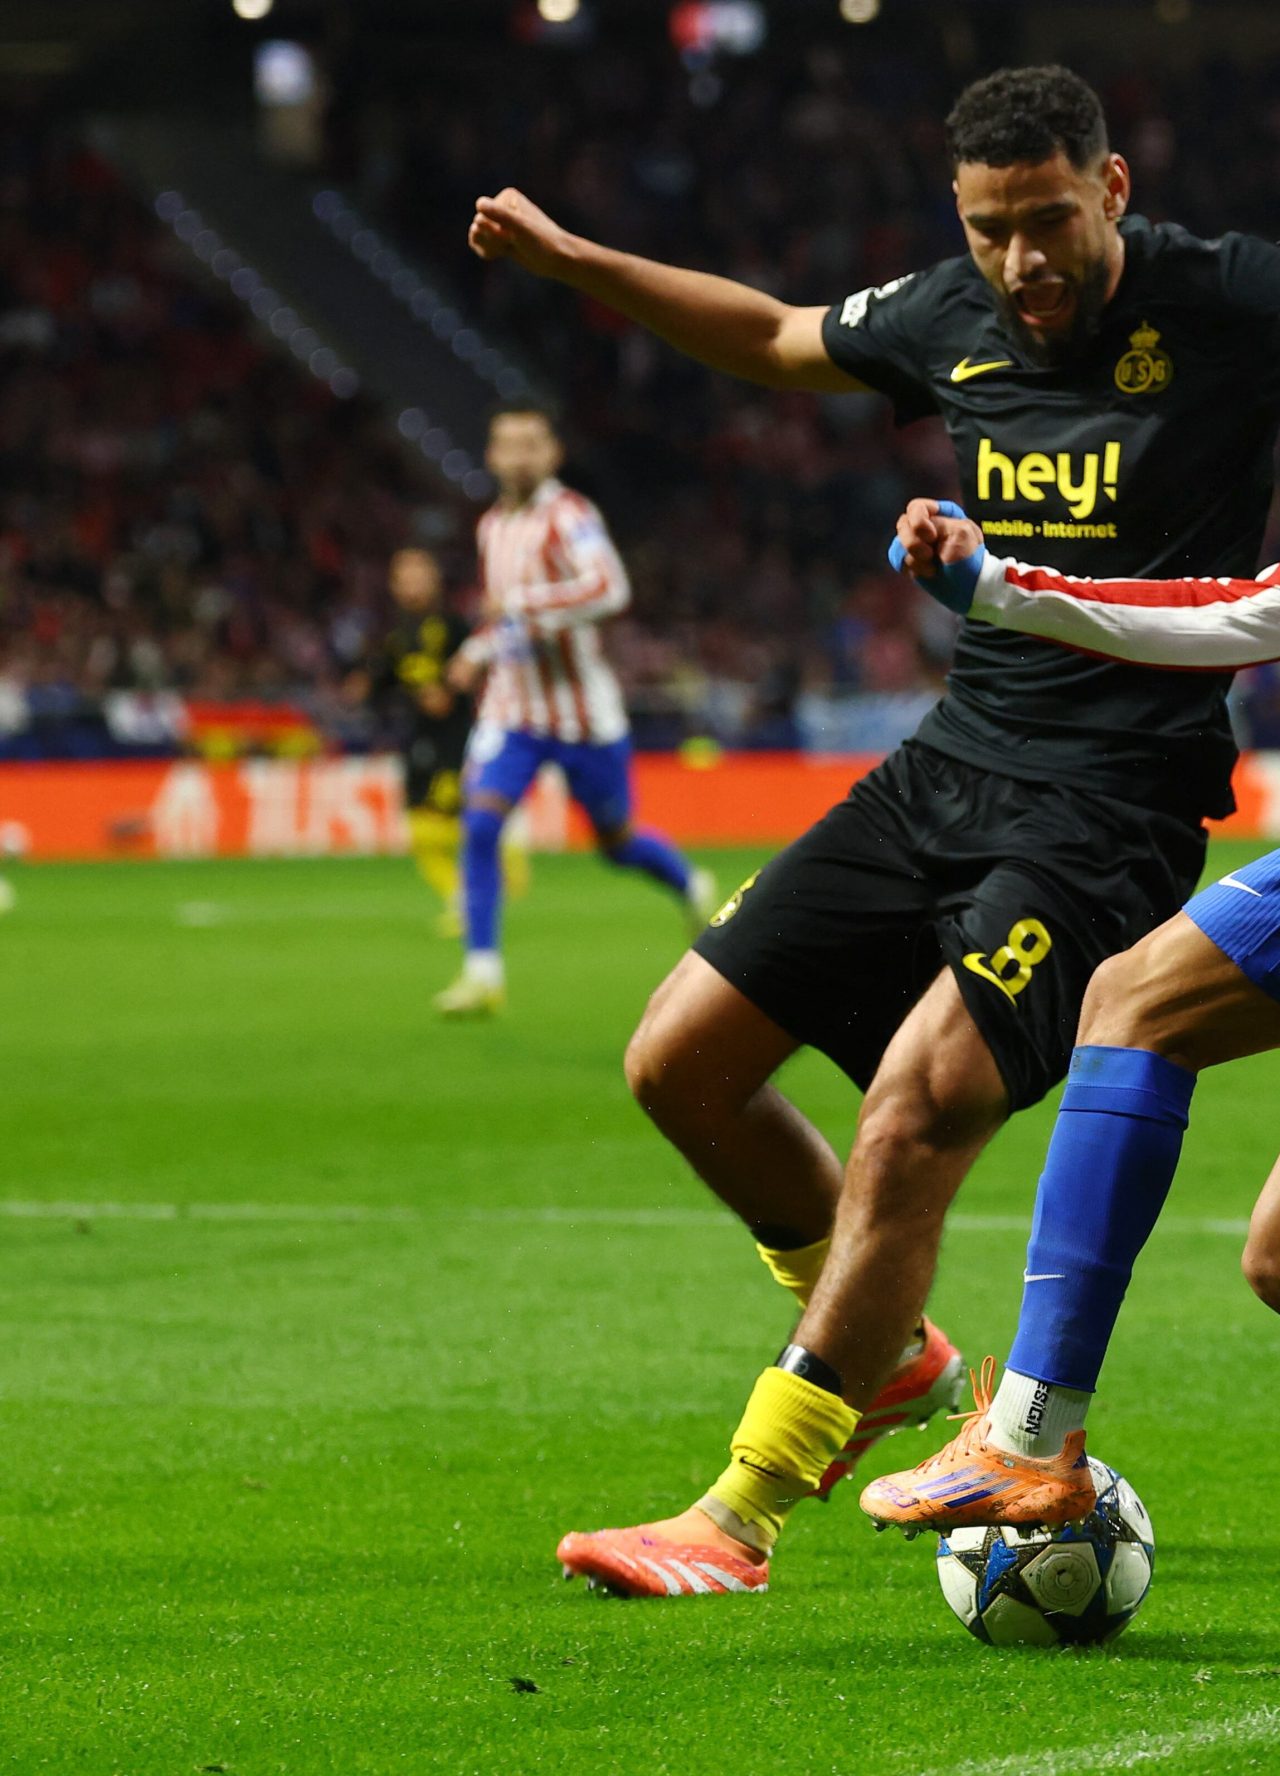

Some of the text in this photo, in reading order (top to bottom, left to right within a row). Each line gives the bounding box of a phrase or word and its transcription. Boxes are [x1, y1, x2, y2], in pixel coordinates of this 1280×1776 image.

[978, 438, 1121, 520] hey!
[981, 519, 1118, 538] mobile internet
[990, 917, 1053, 996] 8
